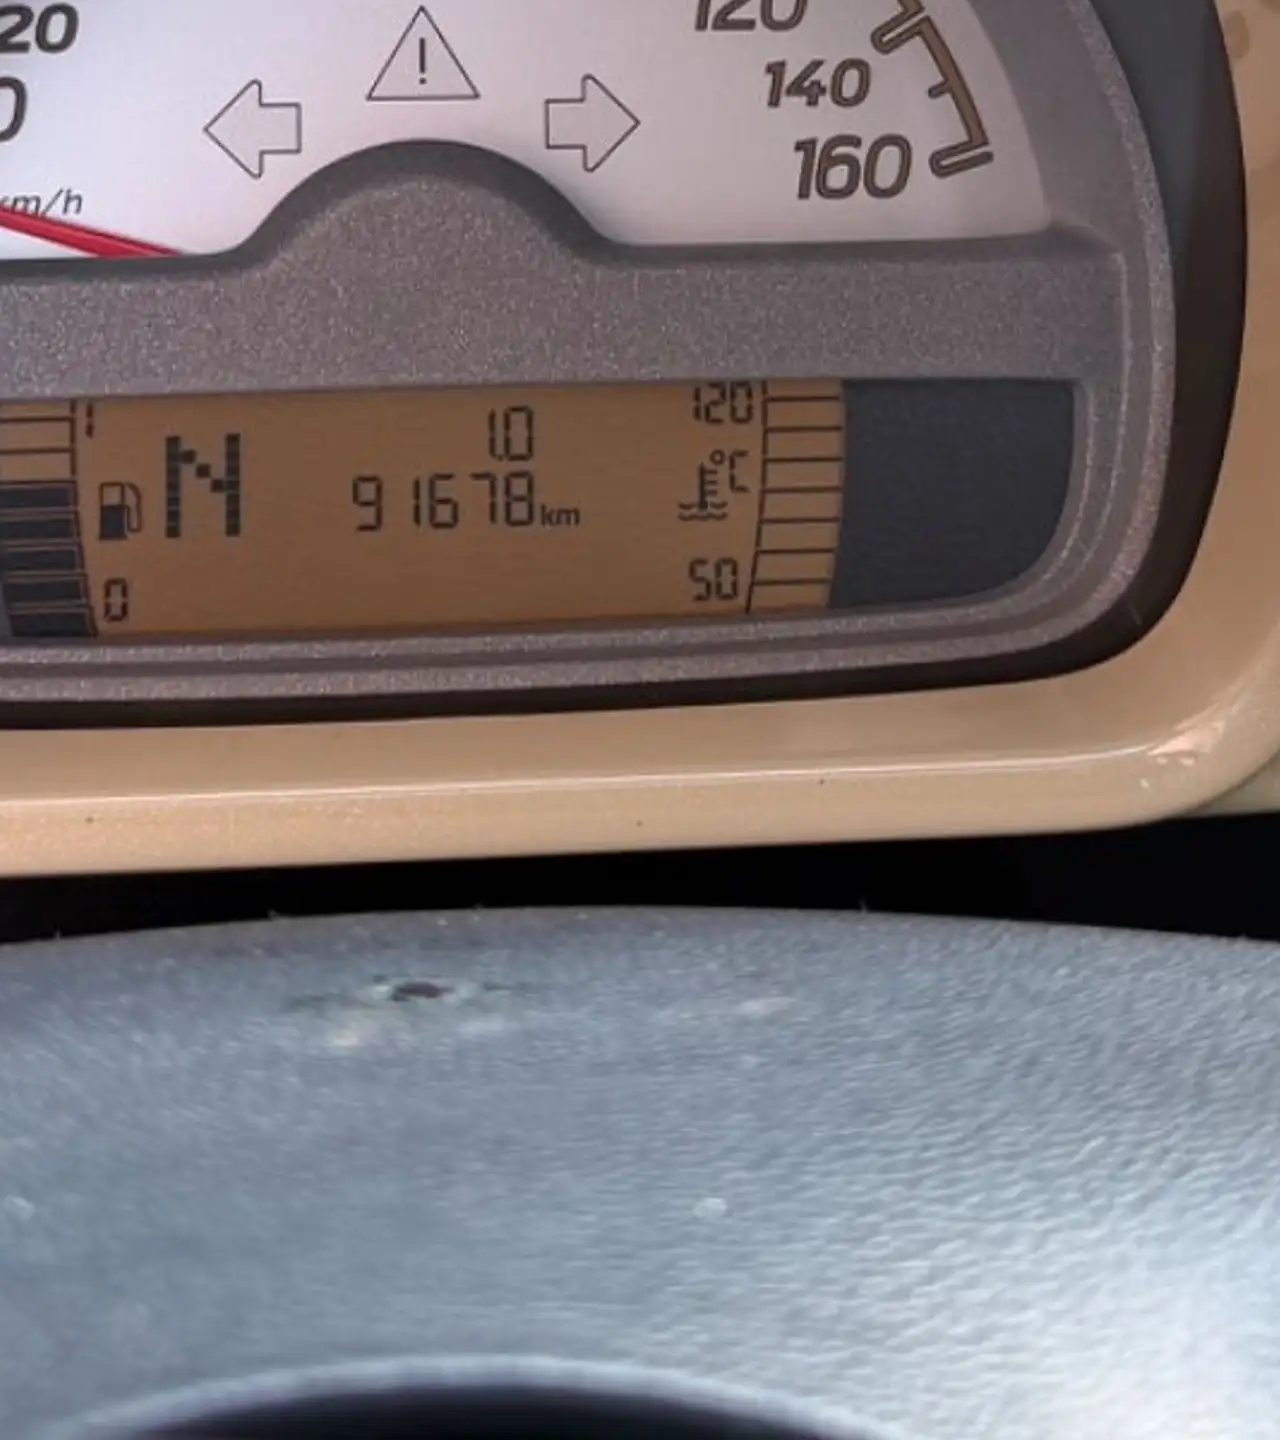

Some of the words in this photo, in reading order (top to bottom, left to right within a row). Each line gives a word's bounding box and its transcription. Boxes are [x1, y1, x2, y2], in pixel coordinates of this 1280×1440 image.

[765, 59, 871, 108] 140
[793, 134, 912, 199] 160
[693, 381, 753, 423] 120
[165, 433, 241, 539] N
[352, 471, 534, 531] 91678
[540, 504, 580, 527] km
[104, 576, 128, 622] 0
[688, 557, 739, 602] 50
